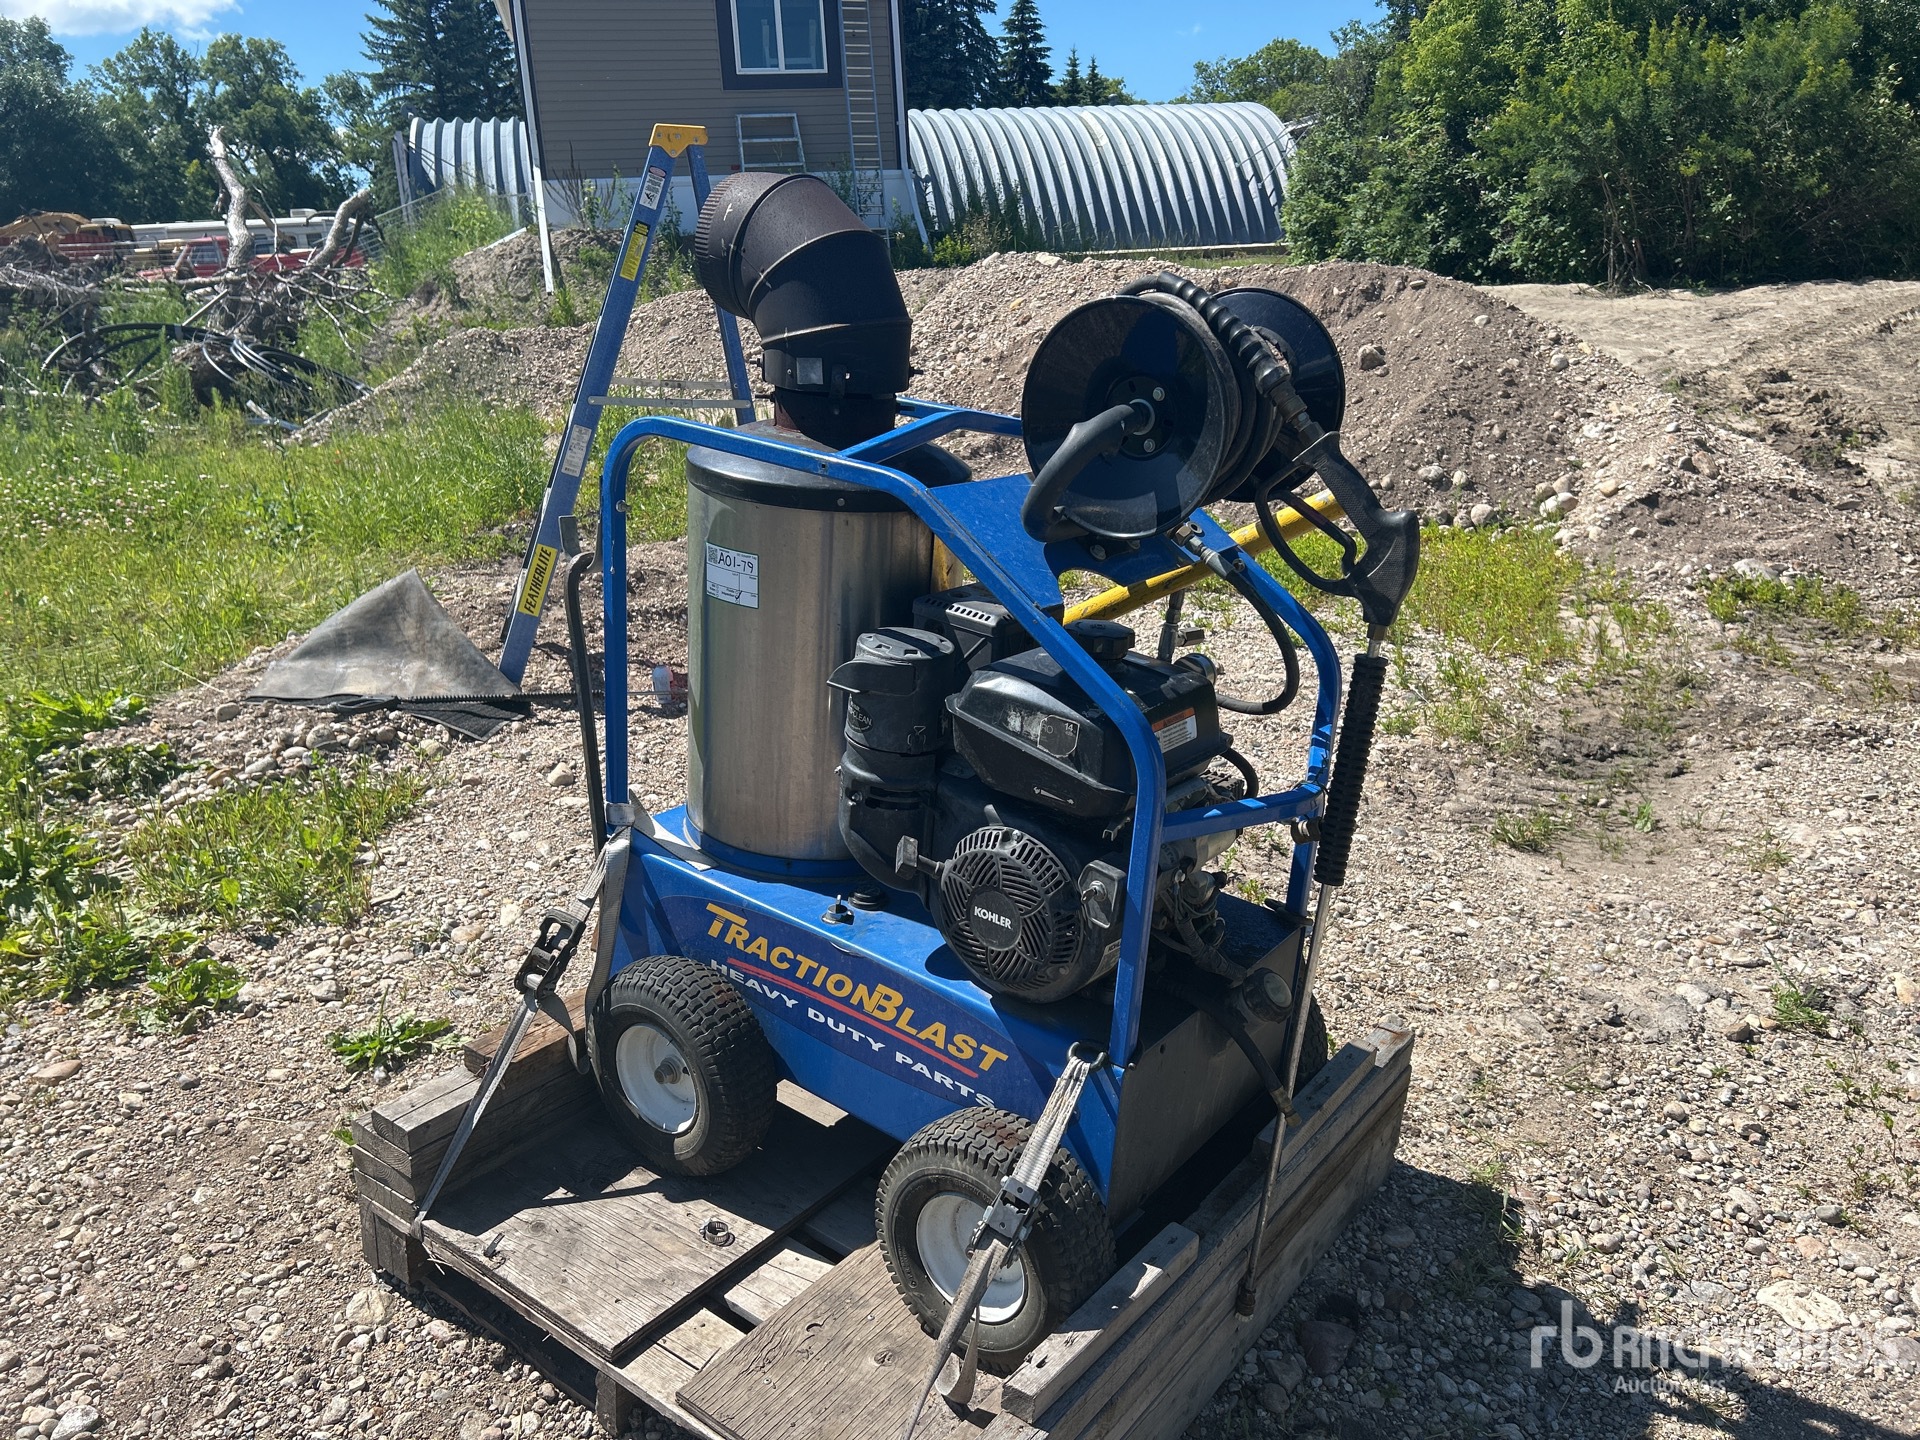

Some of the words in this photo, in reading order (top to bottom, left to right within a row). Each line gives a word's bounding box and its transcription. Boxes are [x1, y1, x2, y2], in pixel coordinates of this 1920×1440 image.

[523, 547, 552, 614] FEATHERLITE
[974, 906, 1012, 930] KOHLER
[711, 959, 799, 1009] HEAVY
[807, 1007, 885, 1052] DUTY
[895, 1051, 996, 1109] PARTS
